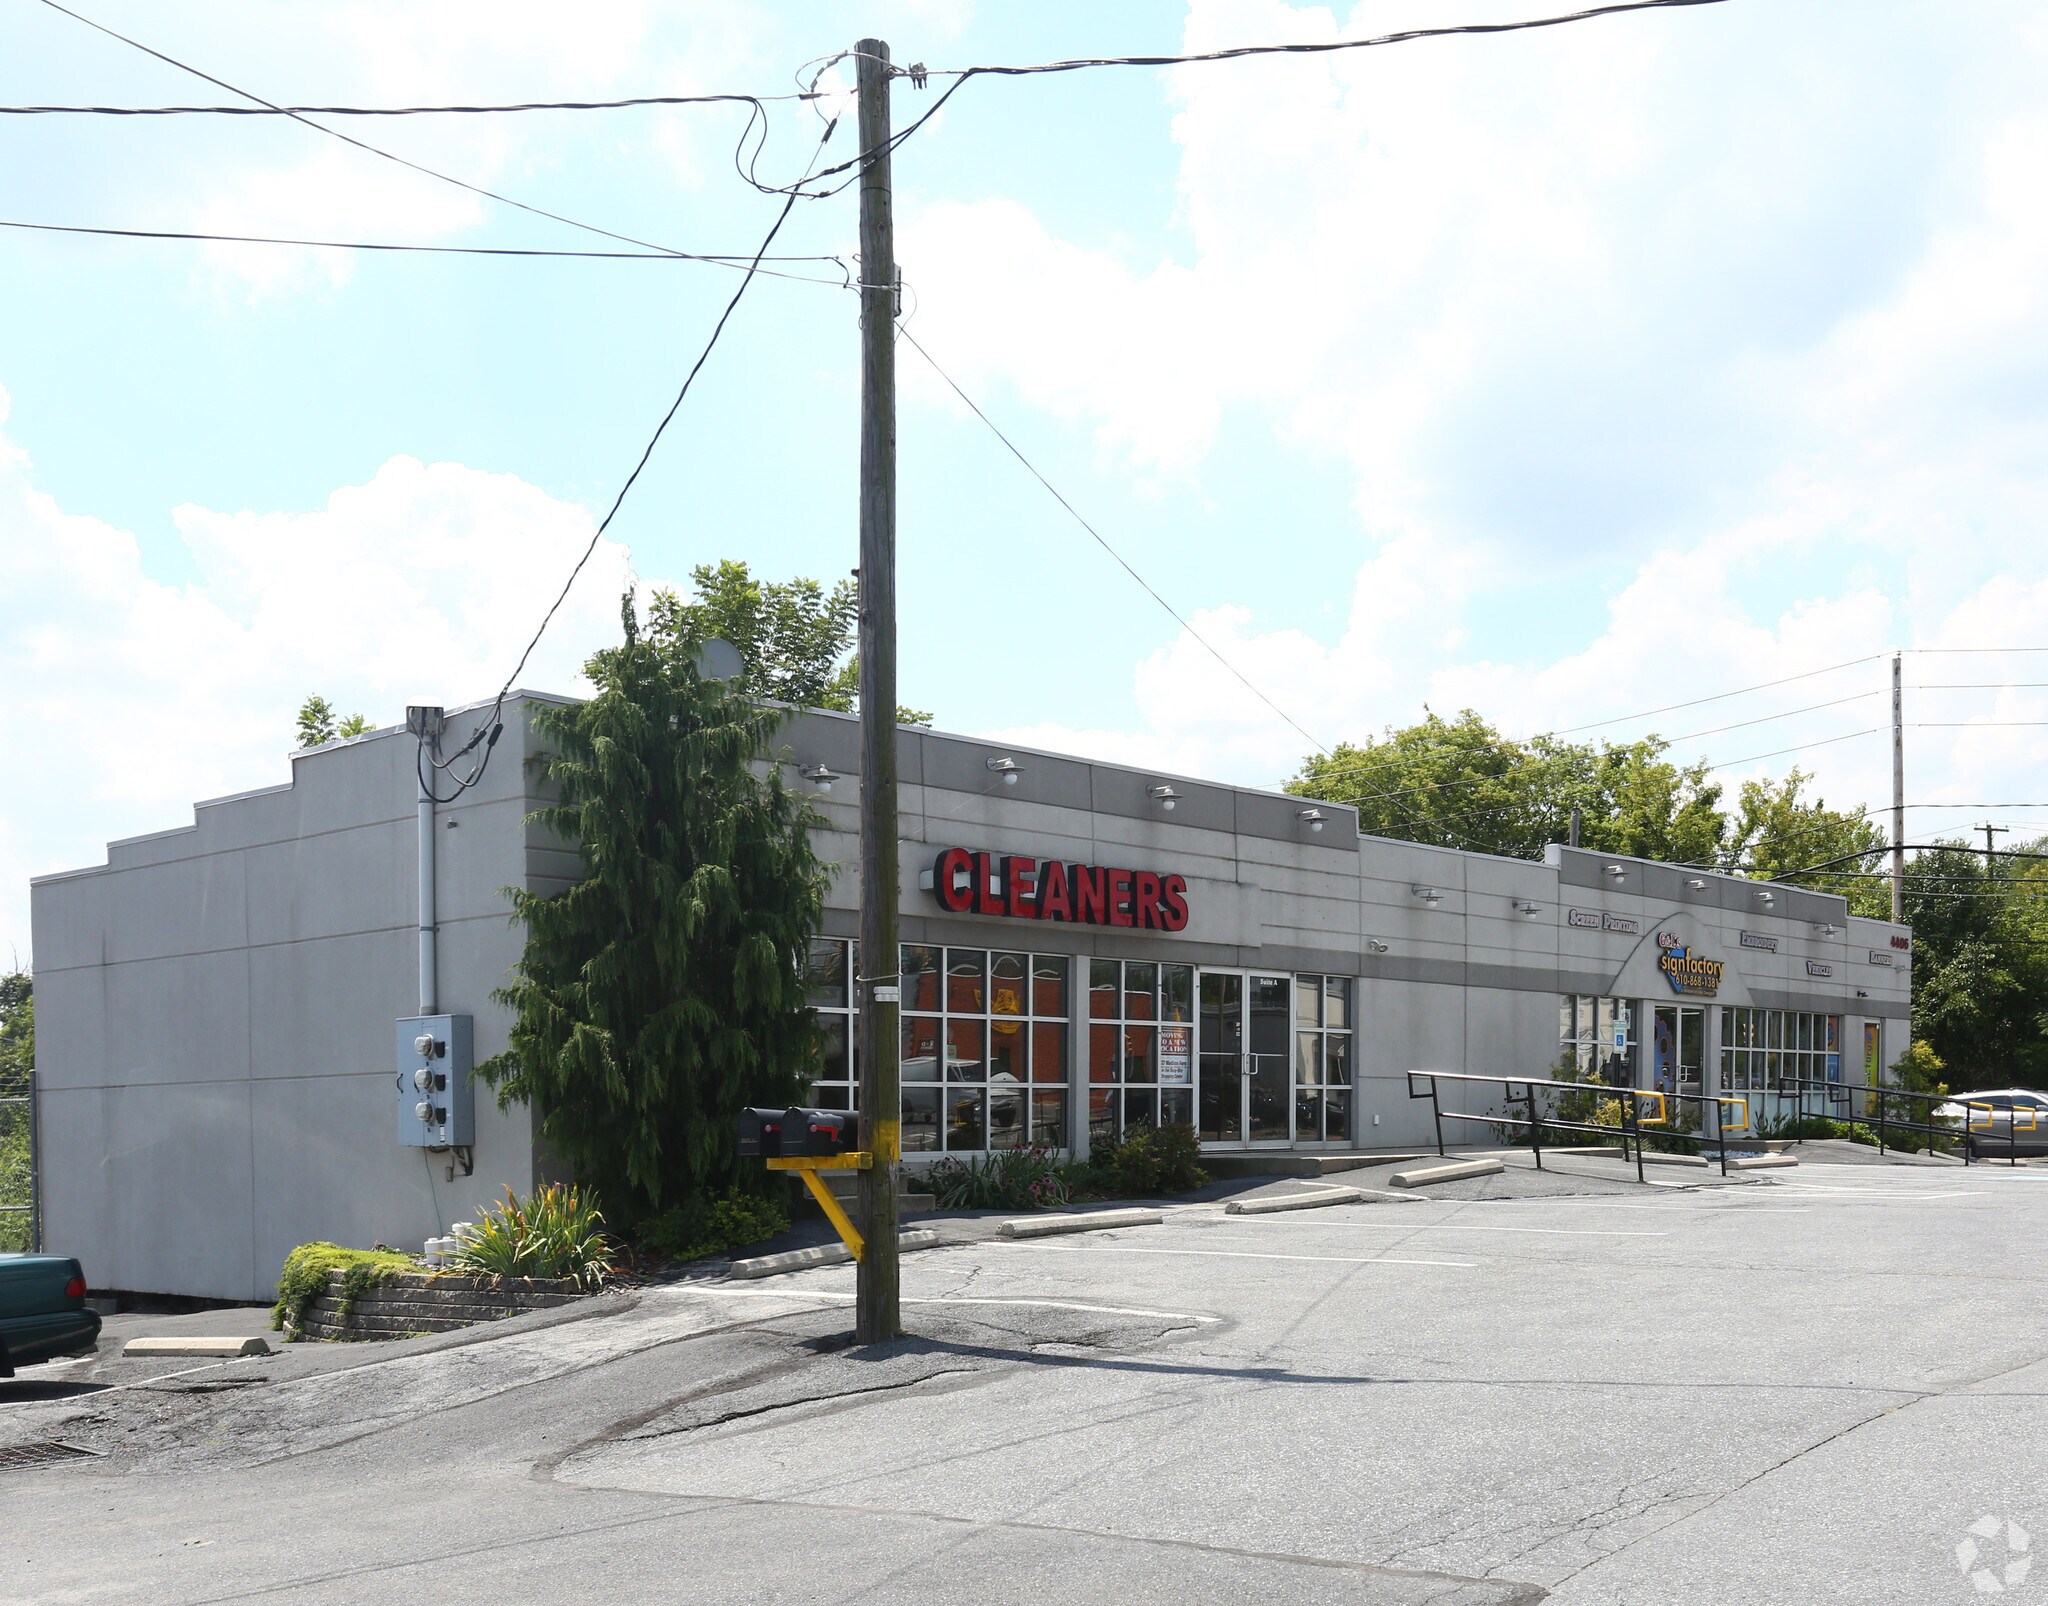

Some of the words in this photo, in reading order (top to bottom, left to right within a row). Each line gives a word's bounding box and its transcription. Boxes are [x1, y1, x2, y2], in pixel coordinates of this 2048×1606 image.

[934, 848, 1189, 931] CLEANERS
[1891, 935, 1909, 950] 4406
[1260, 978, 1273, 986] Suite
[1676, 974, 1719, 989] 610-868-1381
